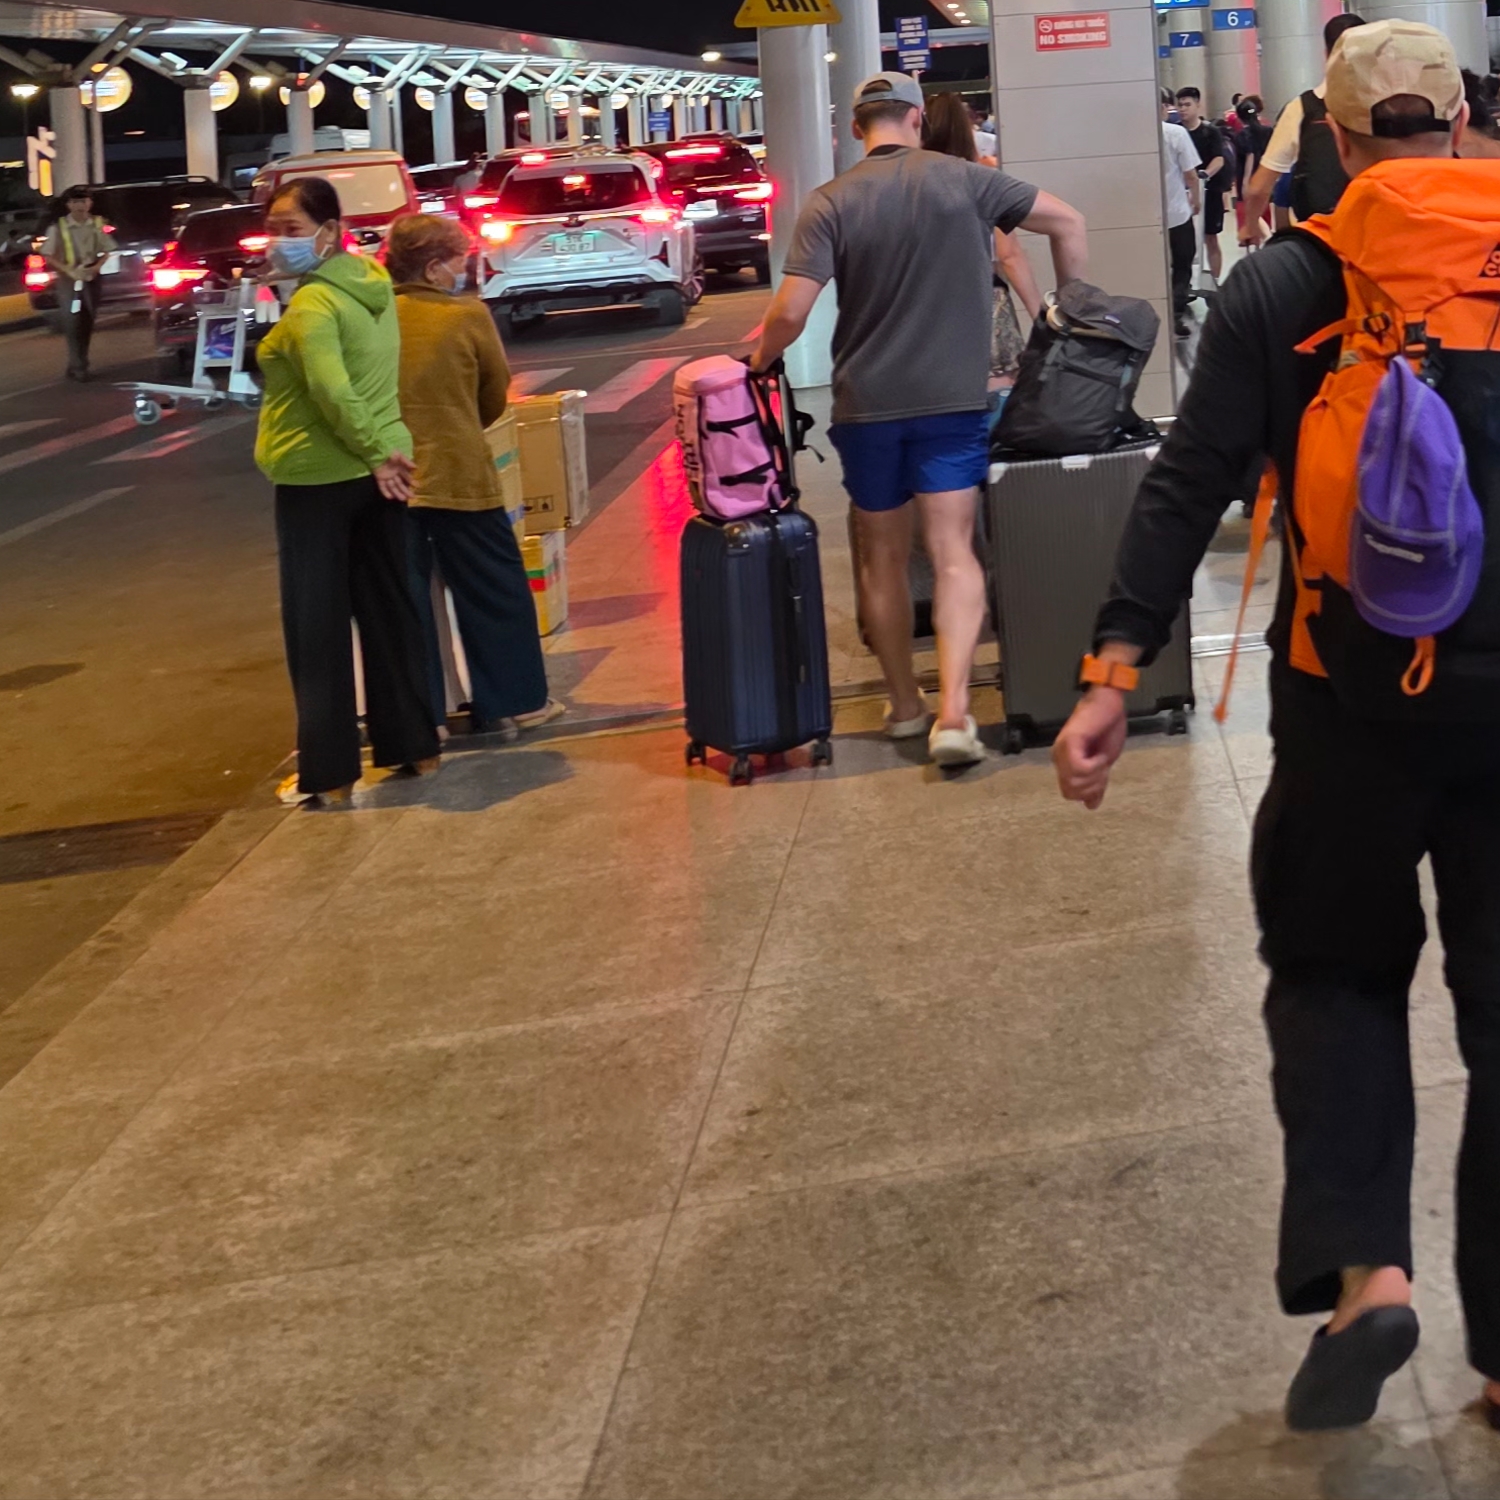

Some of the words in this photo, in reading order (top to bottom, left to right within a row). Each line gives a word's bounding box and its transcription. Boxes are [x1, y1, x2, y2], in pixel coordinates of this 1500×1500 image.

[1227, 11, 1239, 26] 6
[1039, 34, 1055, 45] NO
[1179, 34, 1190, 45] 7
